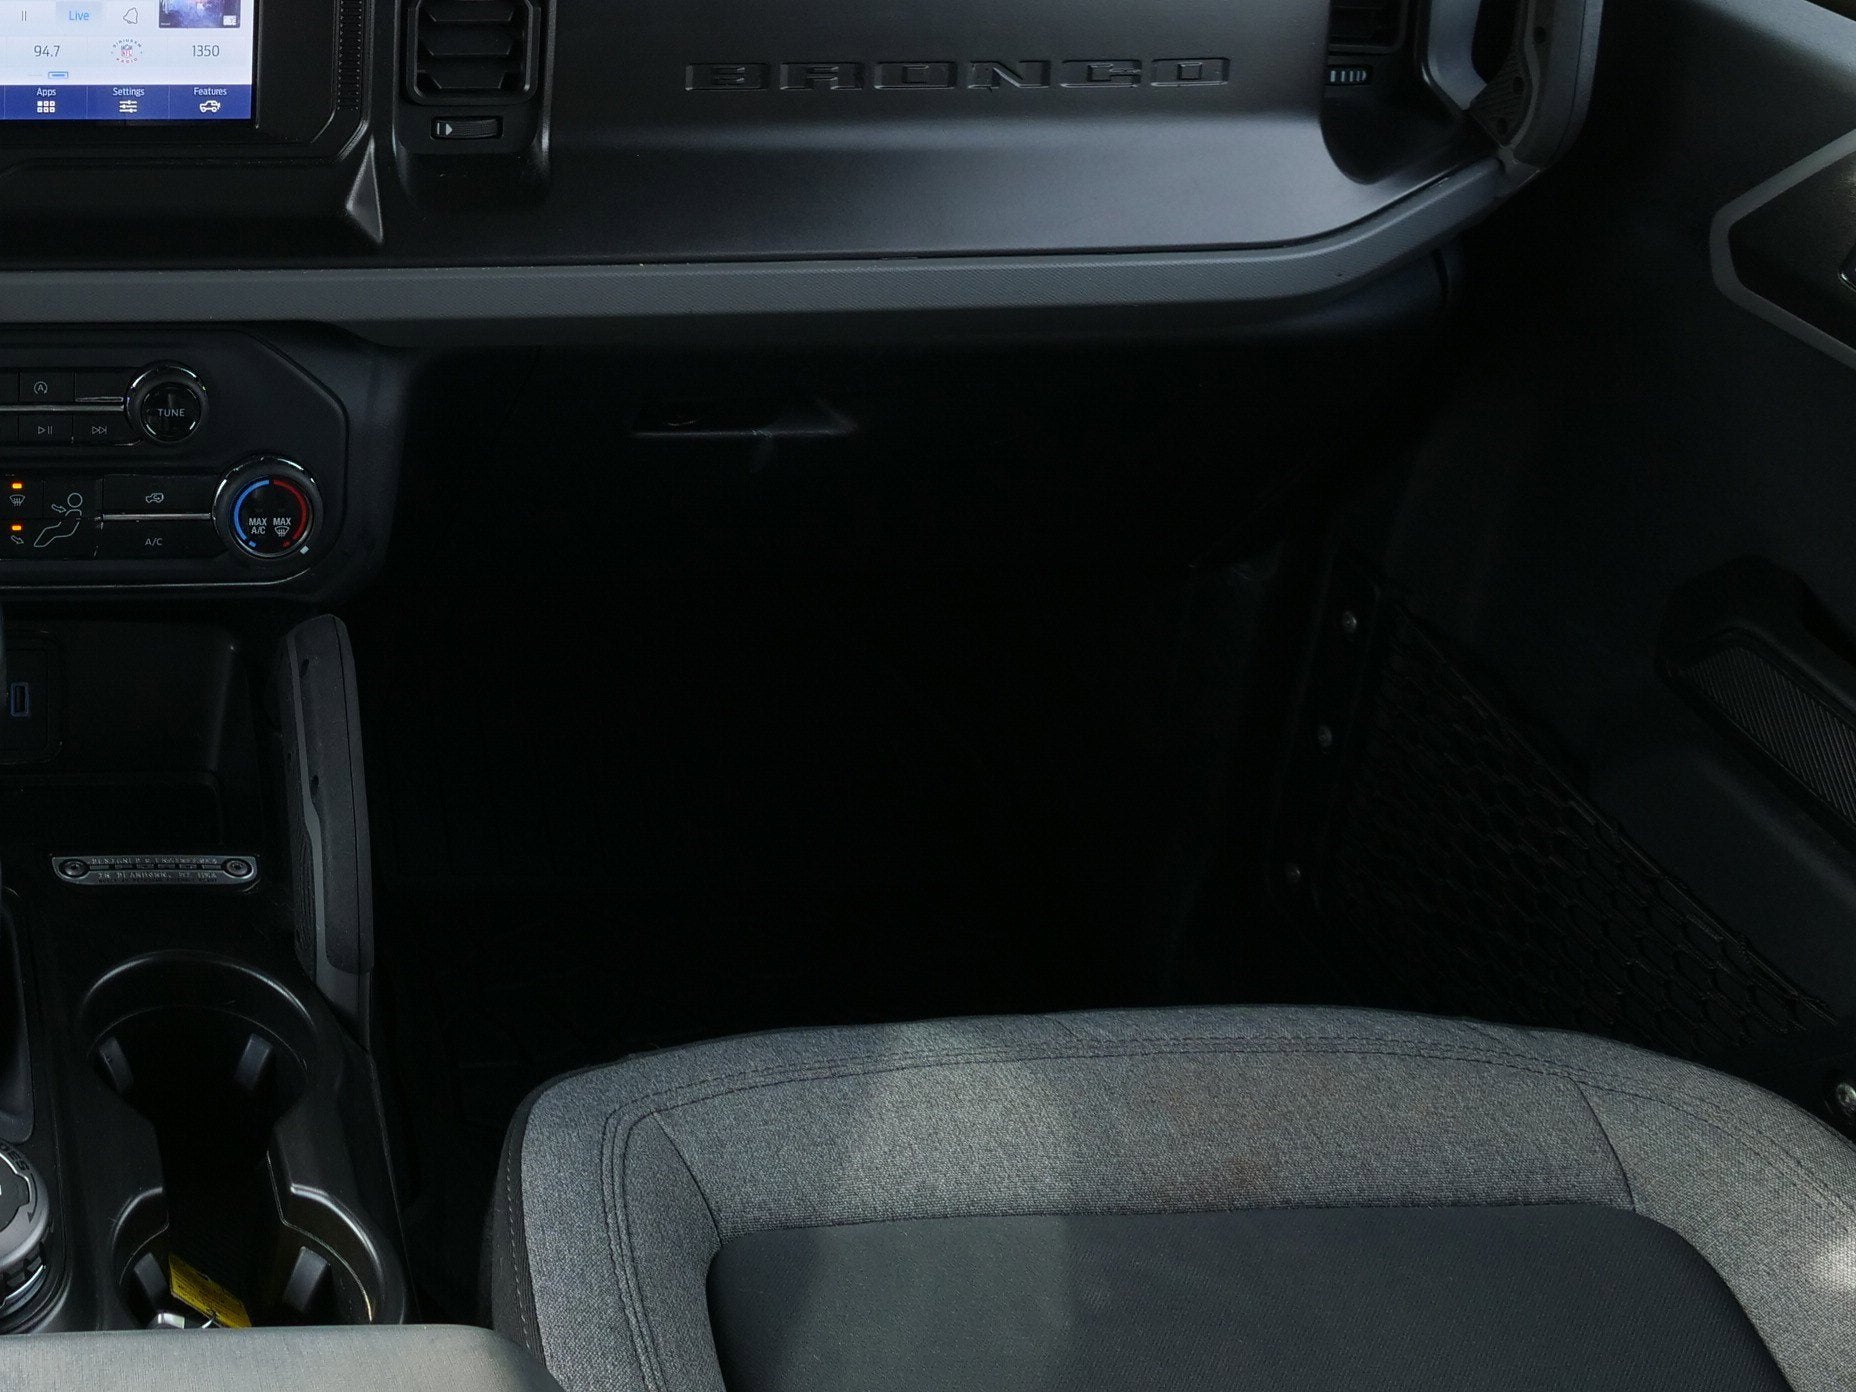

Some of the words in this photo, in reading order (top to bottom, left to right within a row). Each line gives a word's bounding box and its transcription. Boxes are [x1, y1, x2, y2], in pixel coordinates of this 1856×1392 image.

[68, 10, 90, 22] Live
[33, 44, 60, 58] 94.7
[192, 44, 220, 58] 1350
[684, 57, 1231, 93] BRONCO
[36, 87, 56, 98] Apps
[112, 87, 145, 98] Settings
[193, 87, 227, 96] Features
[157, 408, 186, 417] TUNE
[248, 517, 267, 527] MAX
[272, 517, 292, 526] MAX
[250, 526, 266, 535] A/C
[144, 537, 163, 547] A/C
